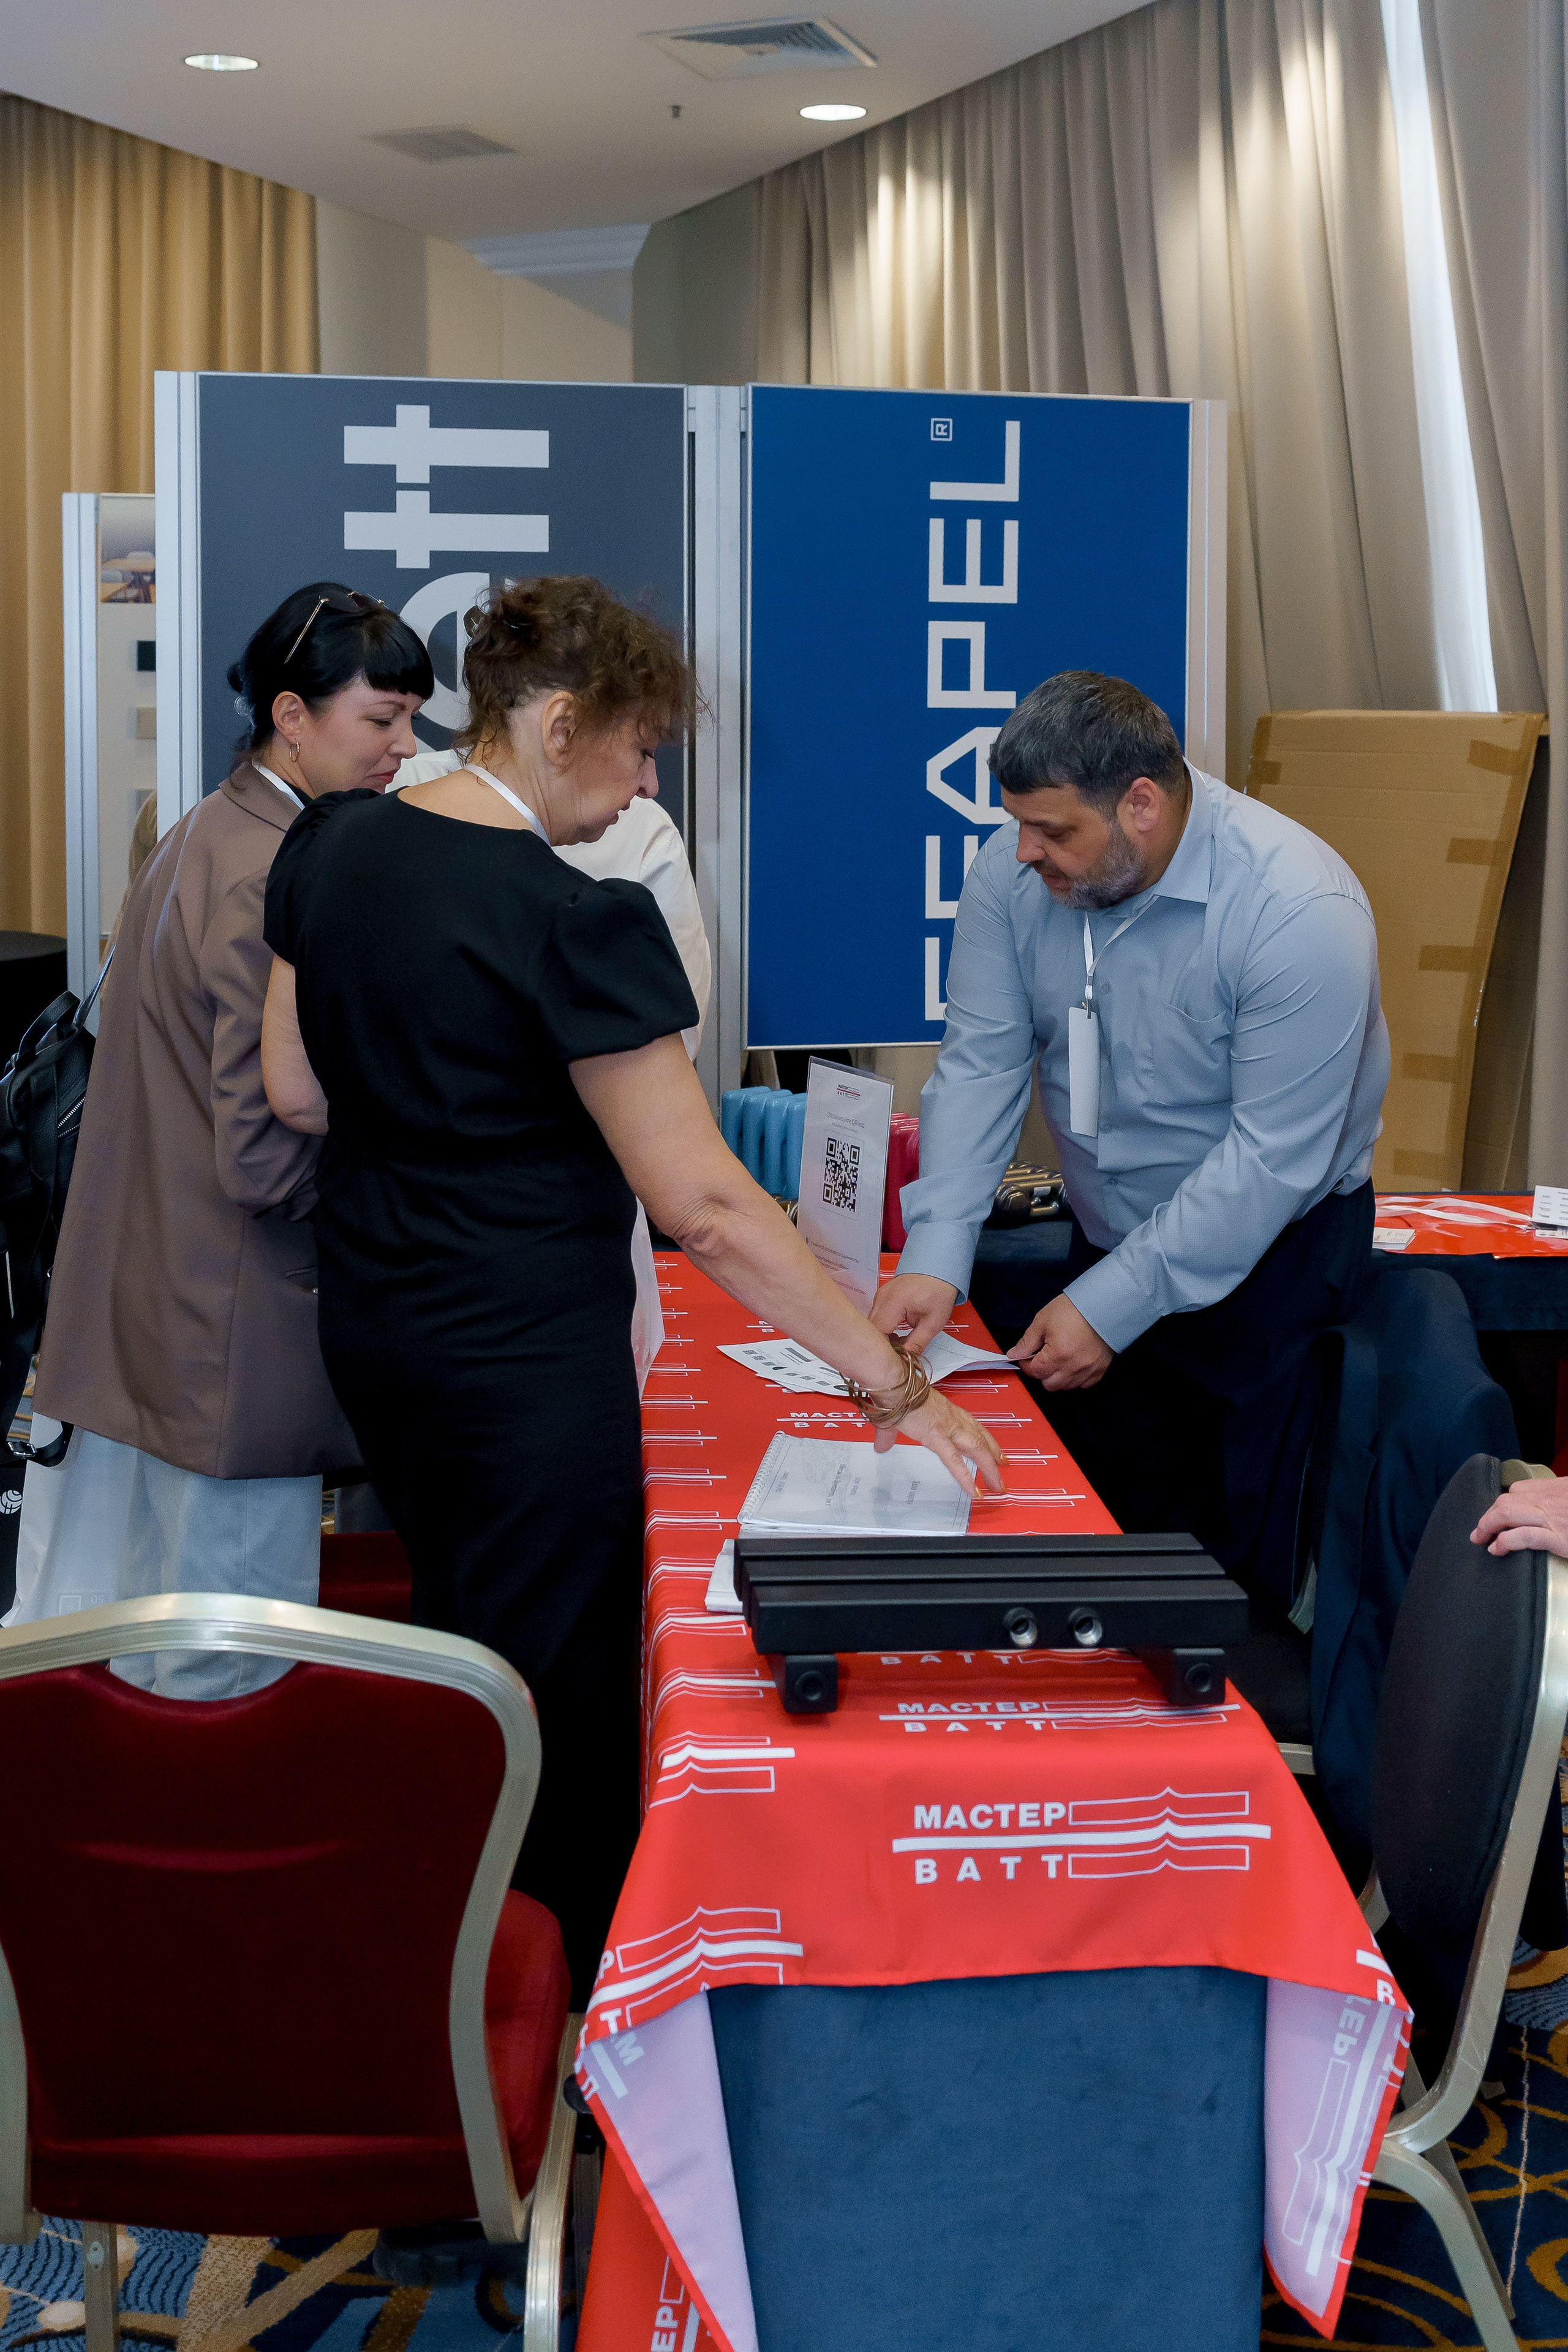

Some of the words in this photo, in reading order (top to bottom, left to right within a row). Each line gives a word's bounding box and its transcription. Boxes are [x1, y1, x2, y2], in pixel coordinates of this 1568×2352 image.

[897, 1701, 1041, 1714] МАСТЕР
[903, 1719, 1046, 1733] ВАТТ
[914, 1801, 1066, 1830] МАСТЕР
[914, 1853, 1064, 1885] ВАТТ
